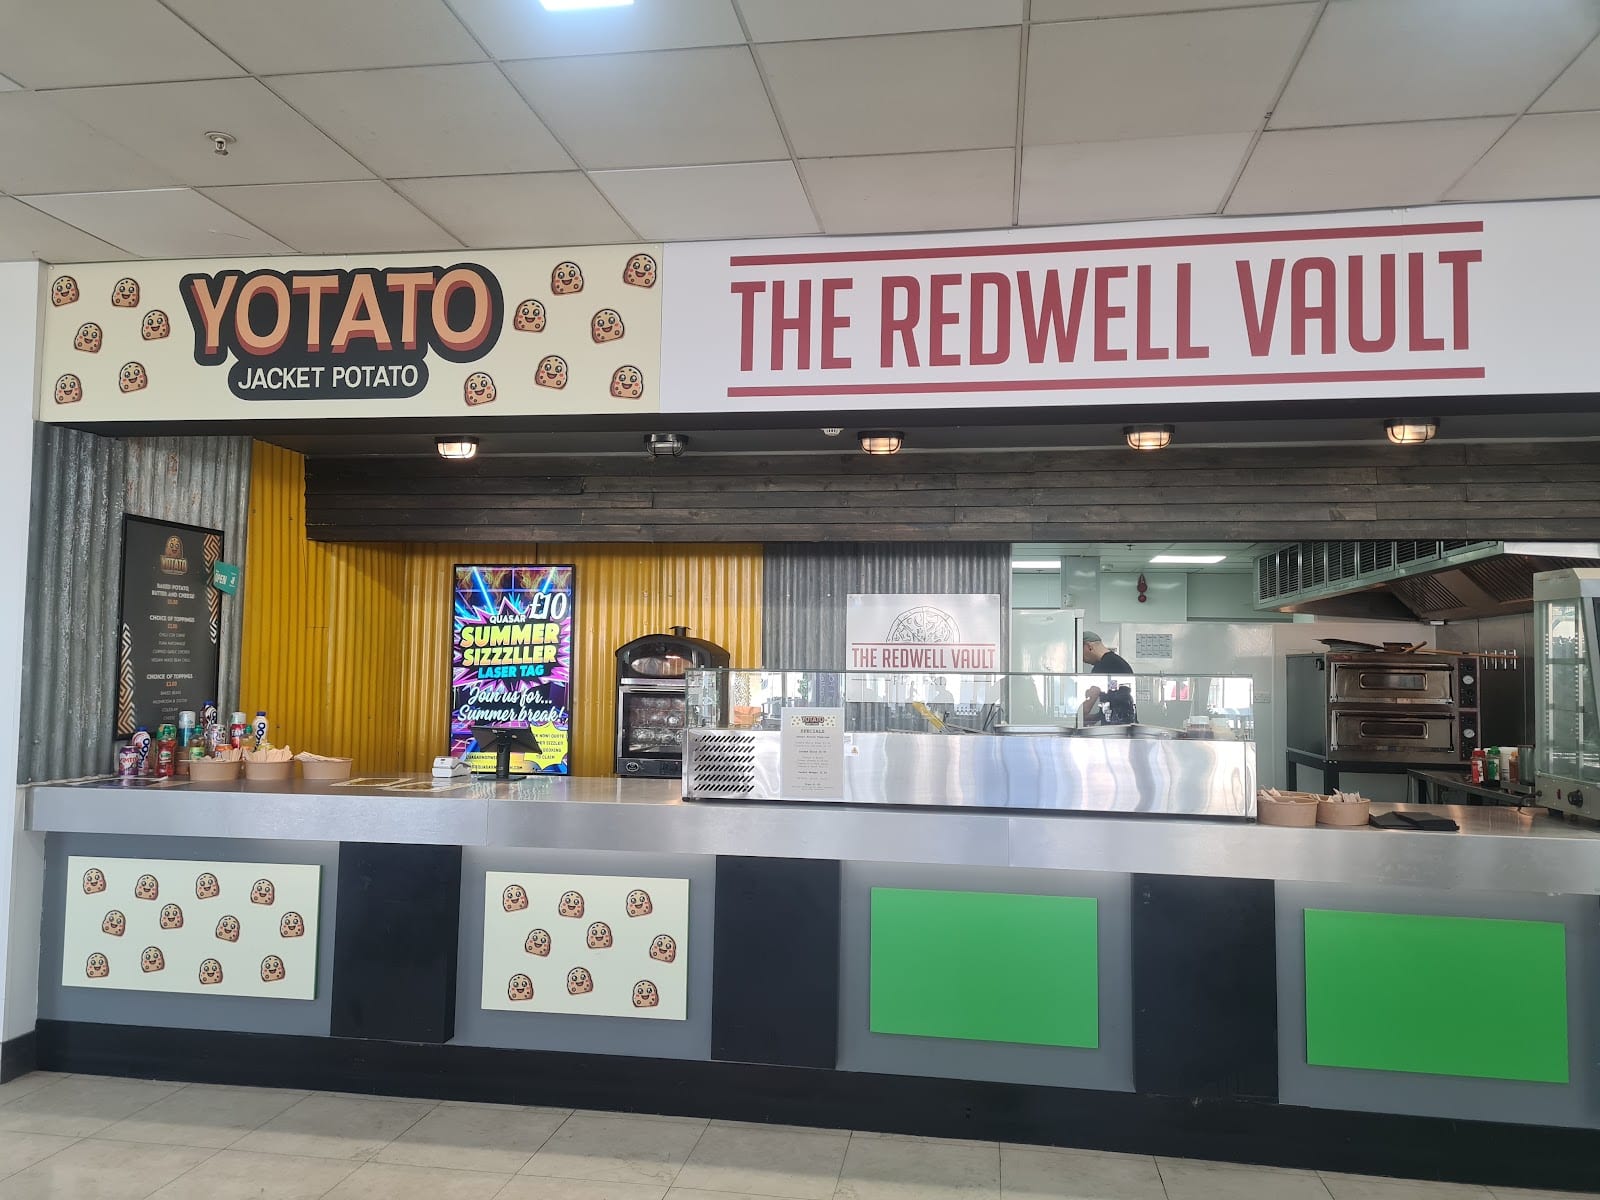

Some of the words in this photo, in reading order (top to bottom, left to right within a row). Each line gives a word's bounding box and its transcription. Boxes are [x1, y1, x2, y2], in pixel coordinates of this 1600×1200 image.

[190, 268, 493, 356] YOTATO
[730, 277, 854, 371] THE
[880, 262, 1210, 368] REDWELL
[1235, 249, 1483, 357] VAULT
[238, 366, 325, 390] JACKET
[332, 364, 419, 388] POTATO
[529, 592, 567, 620] £10
[489, 614, 526, 624] QUASAR
[460, 623, 560, 648] SUMMER
[462, 645, 557, 666] SIZZZLLER
[852, 648, 877, 668] THE
[882, 648, 947, 669] REDWELL
[951, 649, 996, 669] VAULT
[478, 665, 517, 679] LASER
[520, 664, 545, 677] TAG
[468, 686, 501, 705] Join
[501, 691, 520, 703] us
[520, 688, 552, 706] for...
[458, 704, 518, 721] Summer
[518, 705, 565, 722] break!
